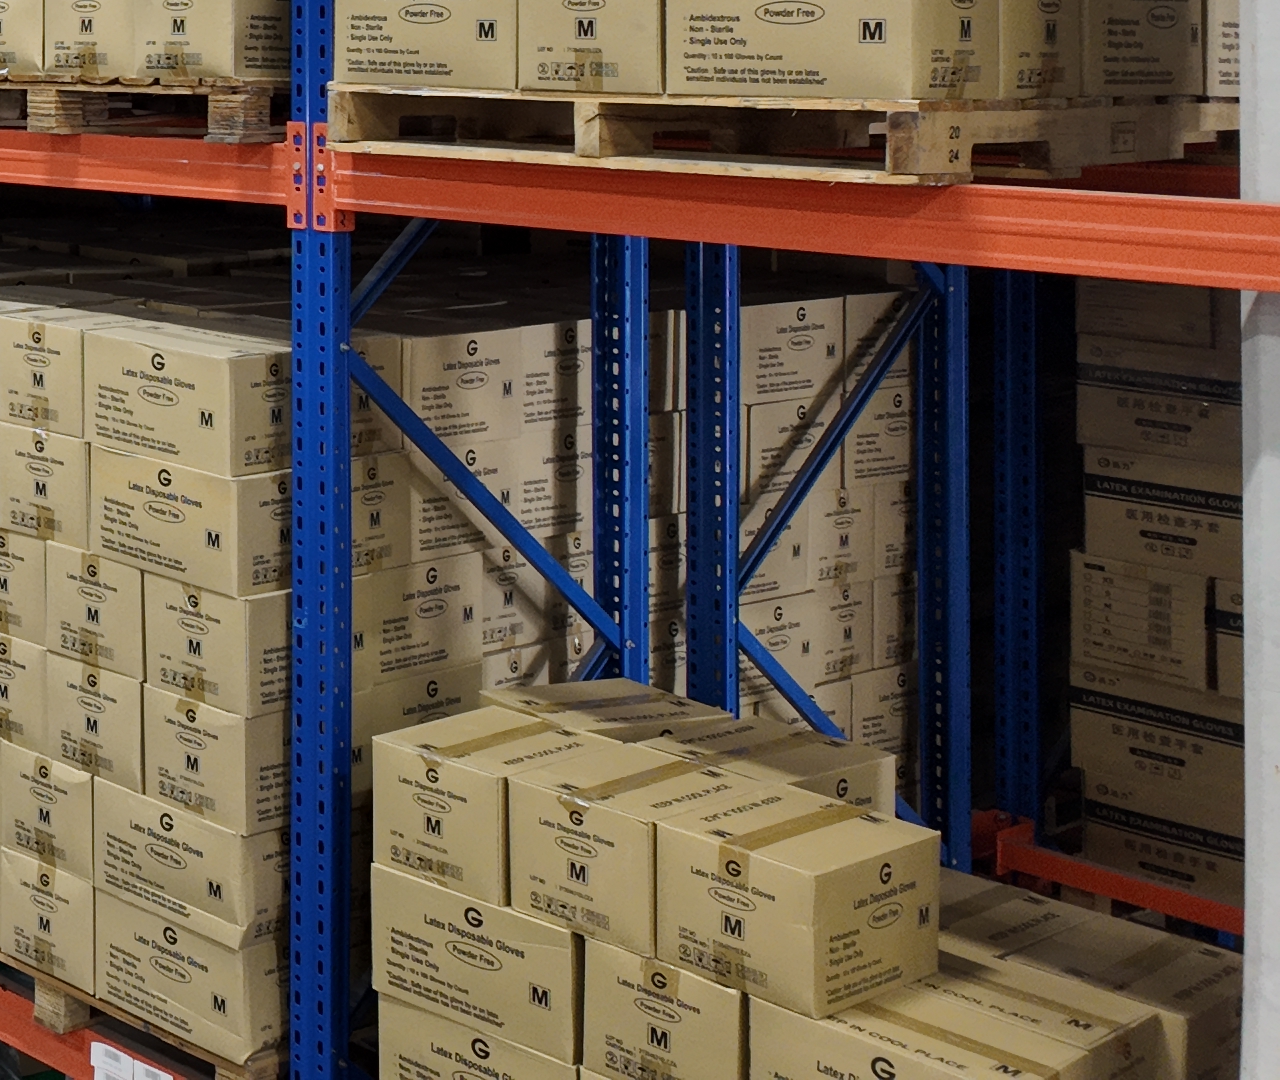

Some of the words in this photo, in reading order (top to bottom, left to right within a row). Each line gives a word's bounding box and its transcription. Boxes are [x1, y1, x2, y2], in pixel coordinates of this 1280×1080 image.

[405, 10, 428, 18] Powder
[430, 10, 444, 18] Free
[689, 14, 740, 22] Ambidextrous
[764, 8, 794, 17] Powder
[797, 8, 815, 17] Free
[479, 22, 494, 38] M
[710, 25, 733, 33] Sterile
[862, 22, 882, 40] M
[689, 38, 711, 46] Single
[730, 38, 747, 47] Only
[948, 126, 961, 138] 20
[948, 149, 960, 162] 24
[151, 353, 165, 371] G
[122, 366, 137, 377] Latex
[140, 371, 172, 385] Disposable
[174, 378, 195, 390] Gloves
[201, 411, 212, 427] M
[1097, 481, 1128, 493] LATEX
[1130, 485, 1206, 505] EXAMINATION
[1082, 694, 1114, 707] LATEX
[1116, 701, 1190, 725] EXAMINATION
[1192, 719, 1234, 736] GLOVES
[464, 907, 483, 928] G
[424, 914, 445, 930] Latex
[448, 923, 493, 947] Disposable
[496, 940, 525, 959] Gloves
[453, 944, 478, 961] Powder
[479, 954, 494, 967] Free
[532, 987, 548, 1007] M
[944, 989, 983, 1006] COOL
[989, 1005, 1042, 1024] PLACE
[849, 1023, 866, 1033] IN
[869, 1031, 908, 1050] COOL
[915, 1049, 969, 1070] PLACE
